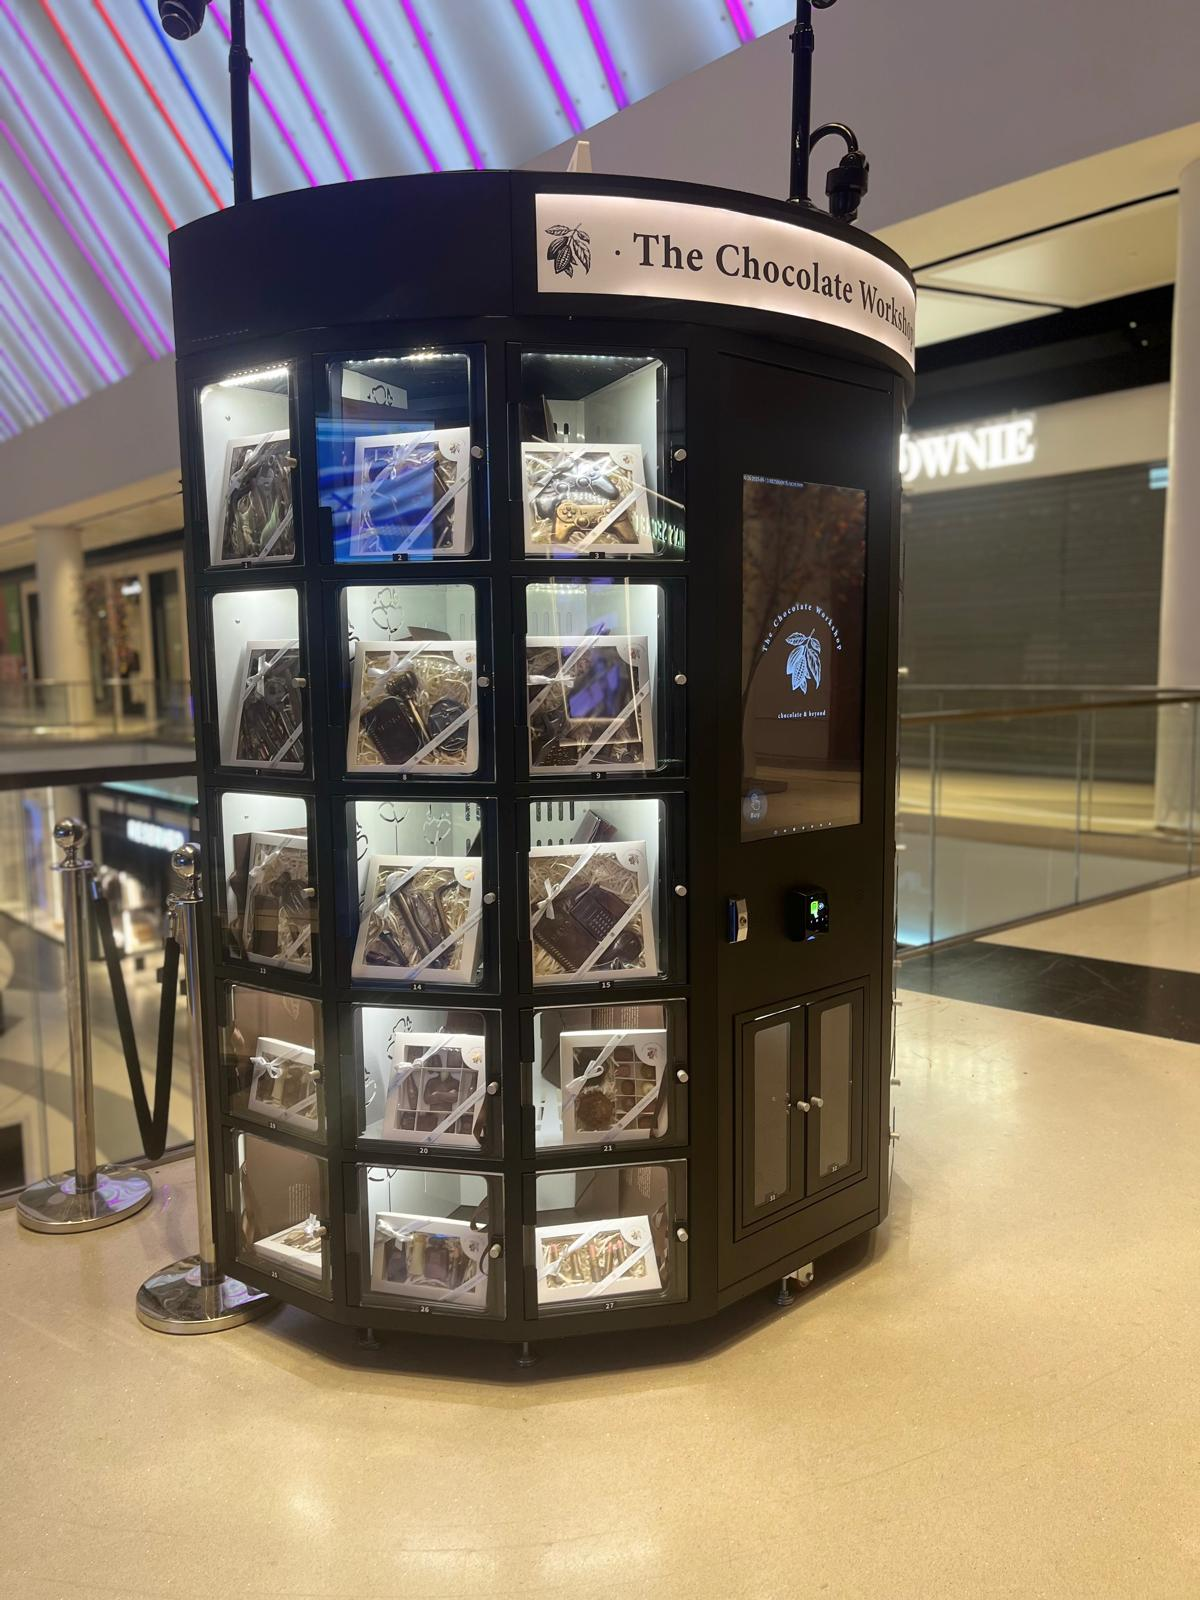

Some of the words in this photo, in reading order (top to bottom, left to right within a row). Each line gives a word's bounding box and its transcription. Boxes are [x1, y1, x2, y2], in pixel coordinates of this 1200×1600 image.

[633, 232, 703, 272] The
[716, 244, 853, 304] Chocolate
[859, 279, 914, 352] Workshop
[762, 632, 773, 653] The
[773, 603, 812, 628] Chocolate
[816, 605, 842, 651] Workshop
[778, 711, 802, 719] chocolate
[808, 709, 826, 717] beyond
